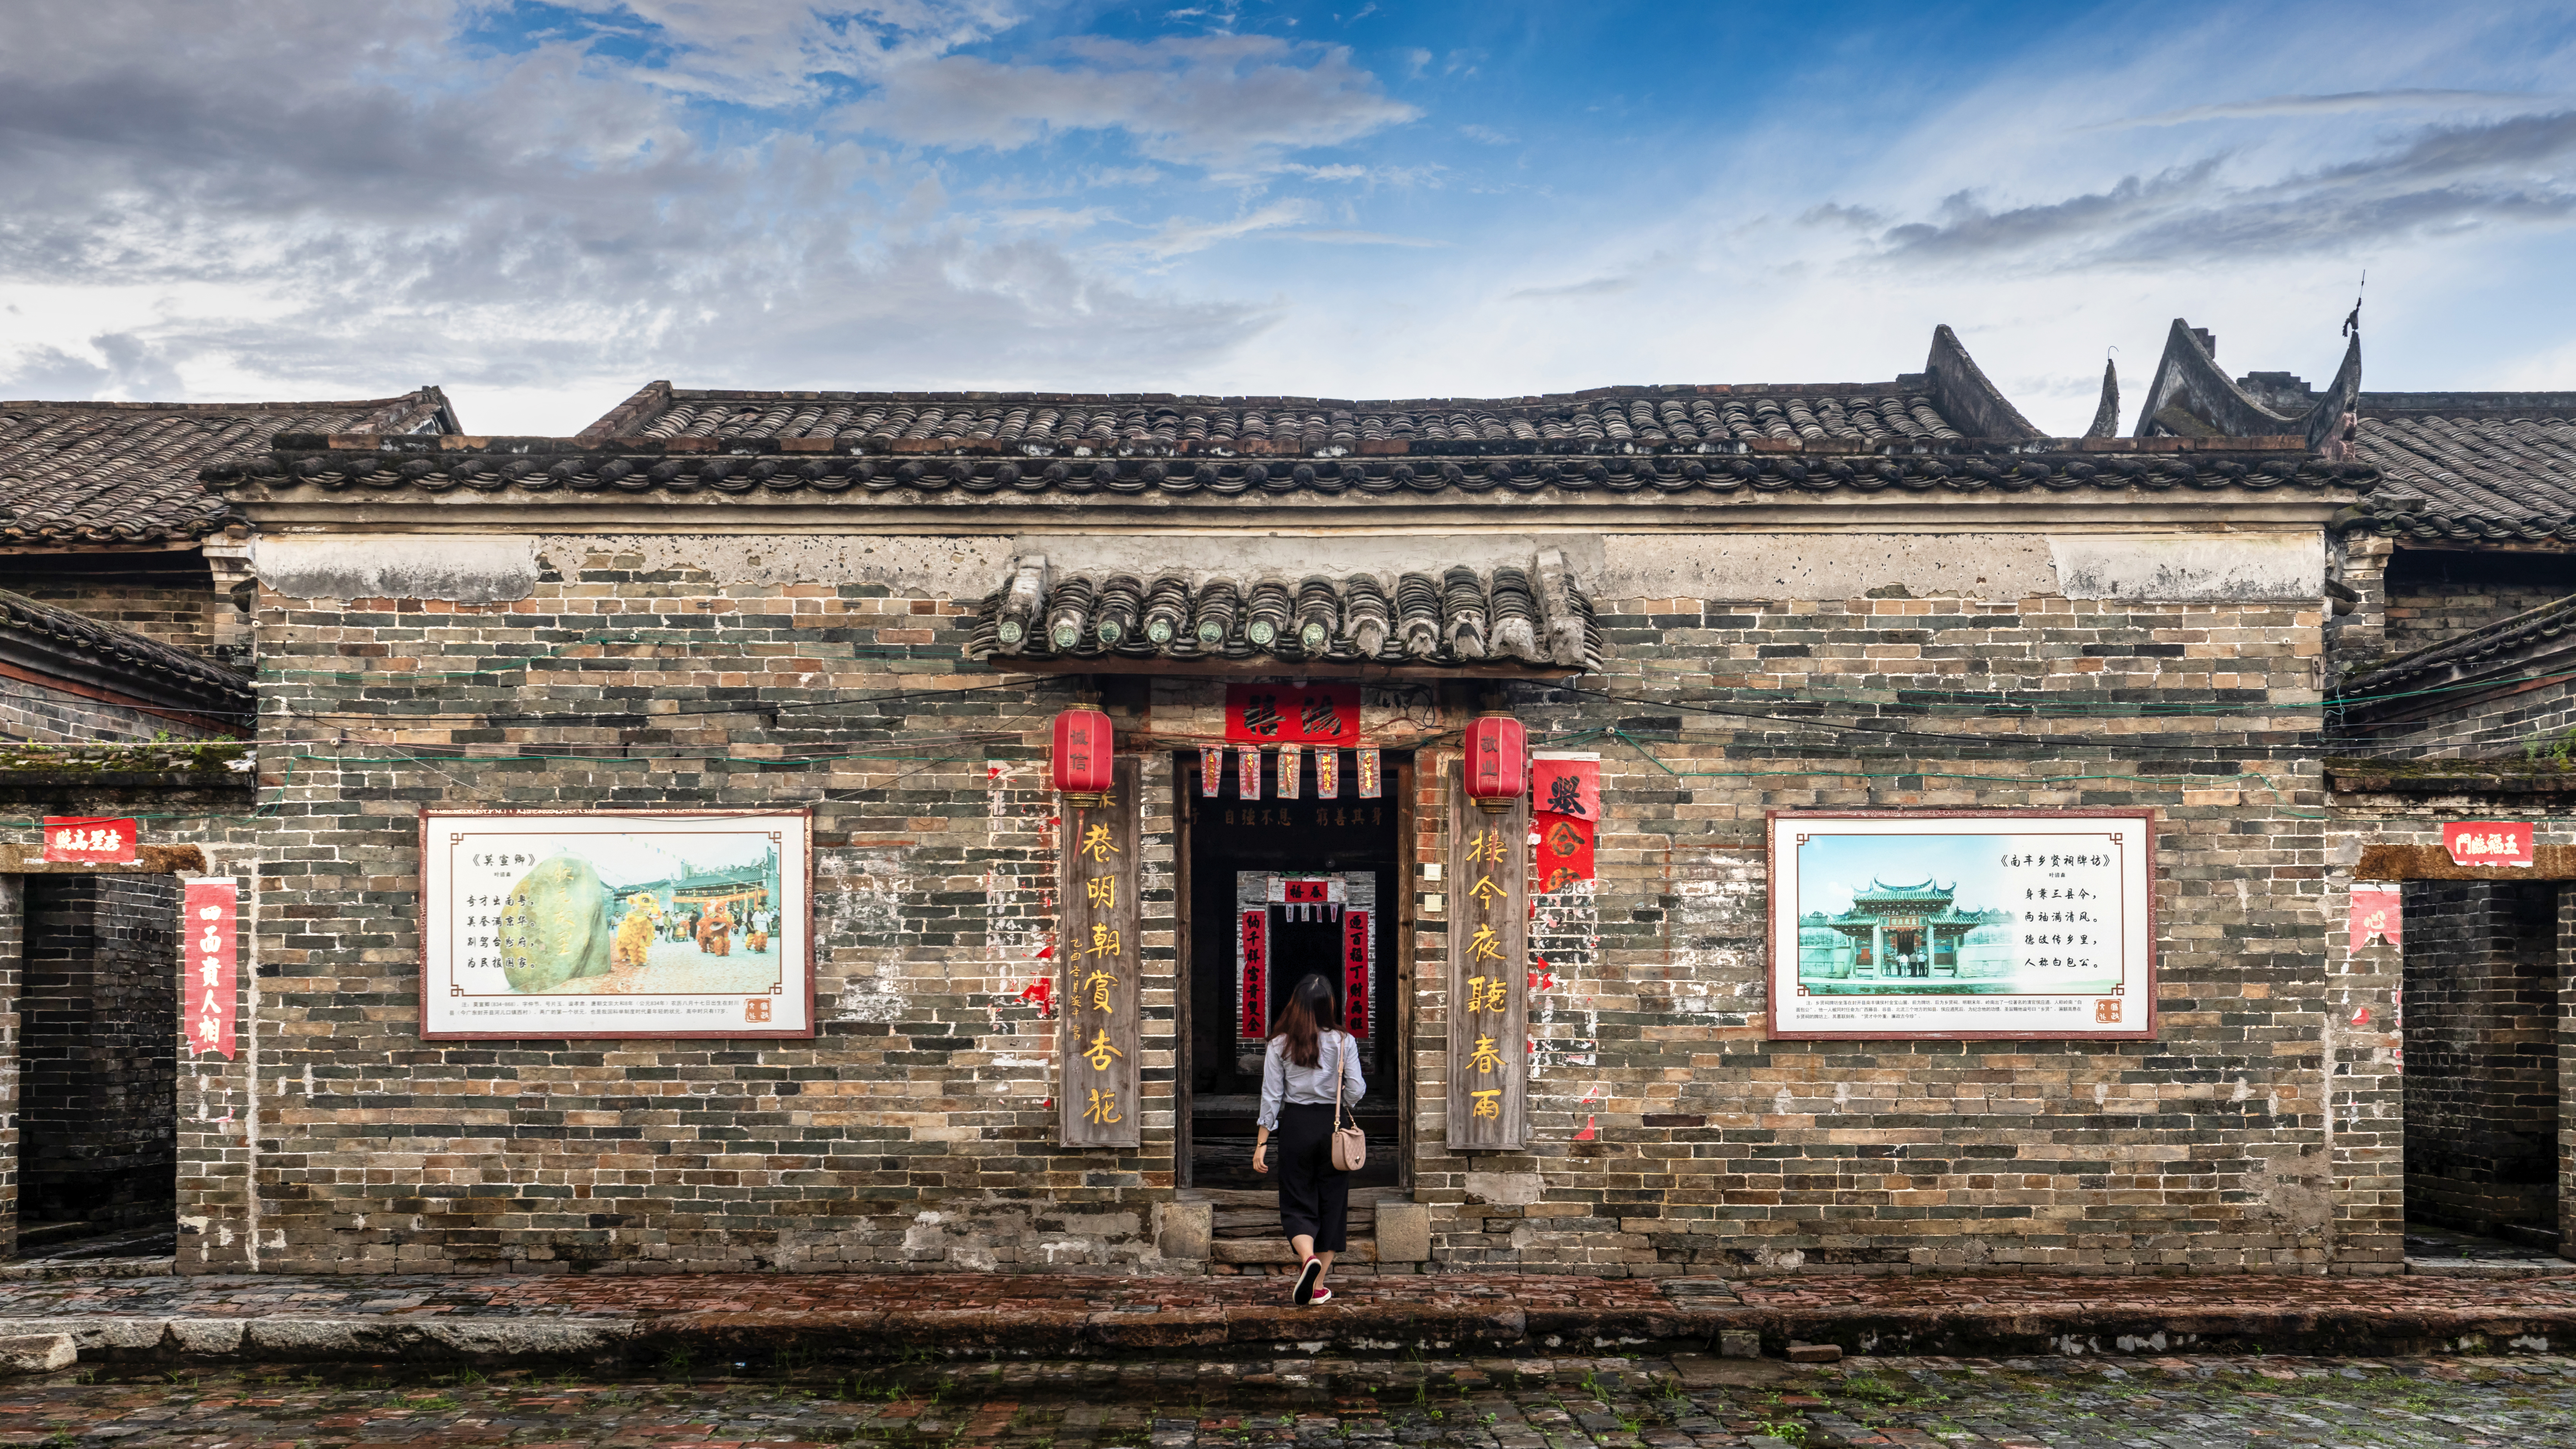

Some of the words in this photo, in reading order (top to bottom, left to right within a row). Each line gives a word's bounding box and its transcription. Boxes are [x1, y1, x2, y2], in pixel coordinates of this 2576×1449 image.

[1070, 729, 1088, 770] 诚信
[1480, 736, 1498, 776] 敬业
[54, 829, 122, 851] 吉星高照
[2455, 833, 2520, 855] 五福臨門
[473, 854, 535, 866] 《莫宣卿》
[2001, 854, 2110, 867] 《南丰乡贤祠牌坊》
[1465, 797, 1508, 1120] 樓今夜聽春雨
[199, 905, 222, 1051] 四面貴人相
